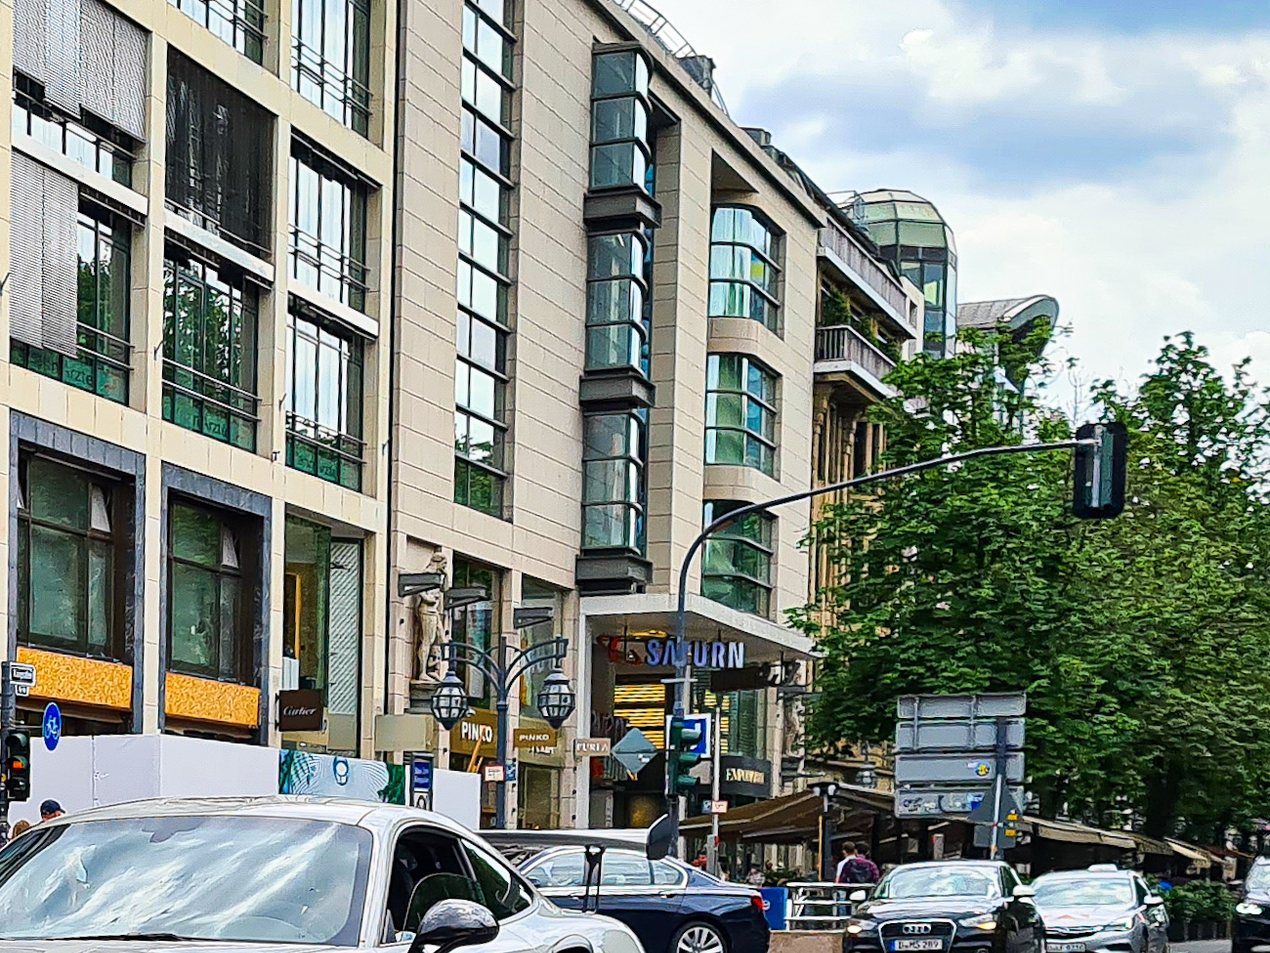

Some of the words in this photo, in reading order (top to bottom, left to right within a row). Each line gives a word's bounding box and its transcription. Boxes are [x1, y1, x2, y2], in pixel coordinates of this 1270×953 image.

[647, 639, 745, 669] SAURN
[283, 705, 318, 716] Cartier
[519, 733, 550, 742] PINKO
